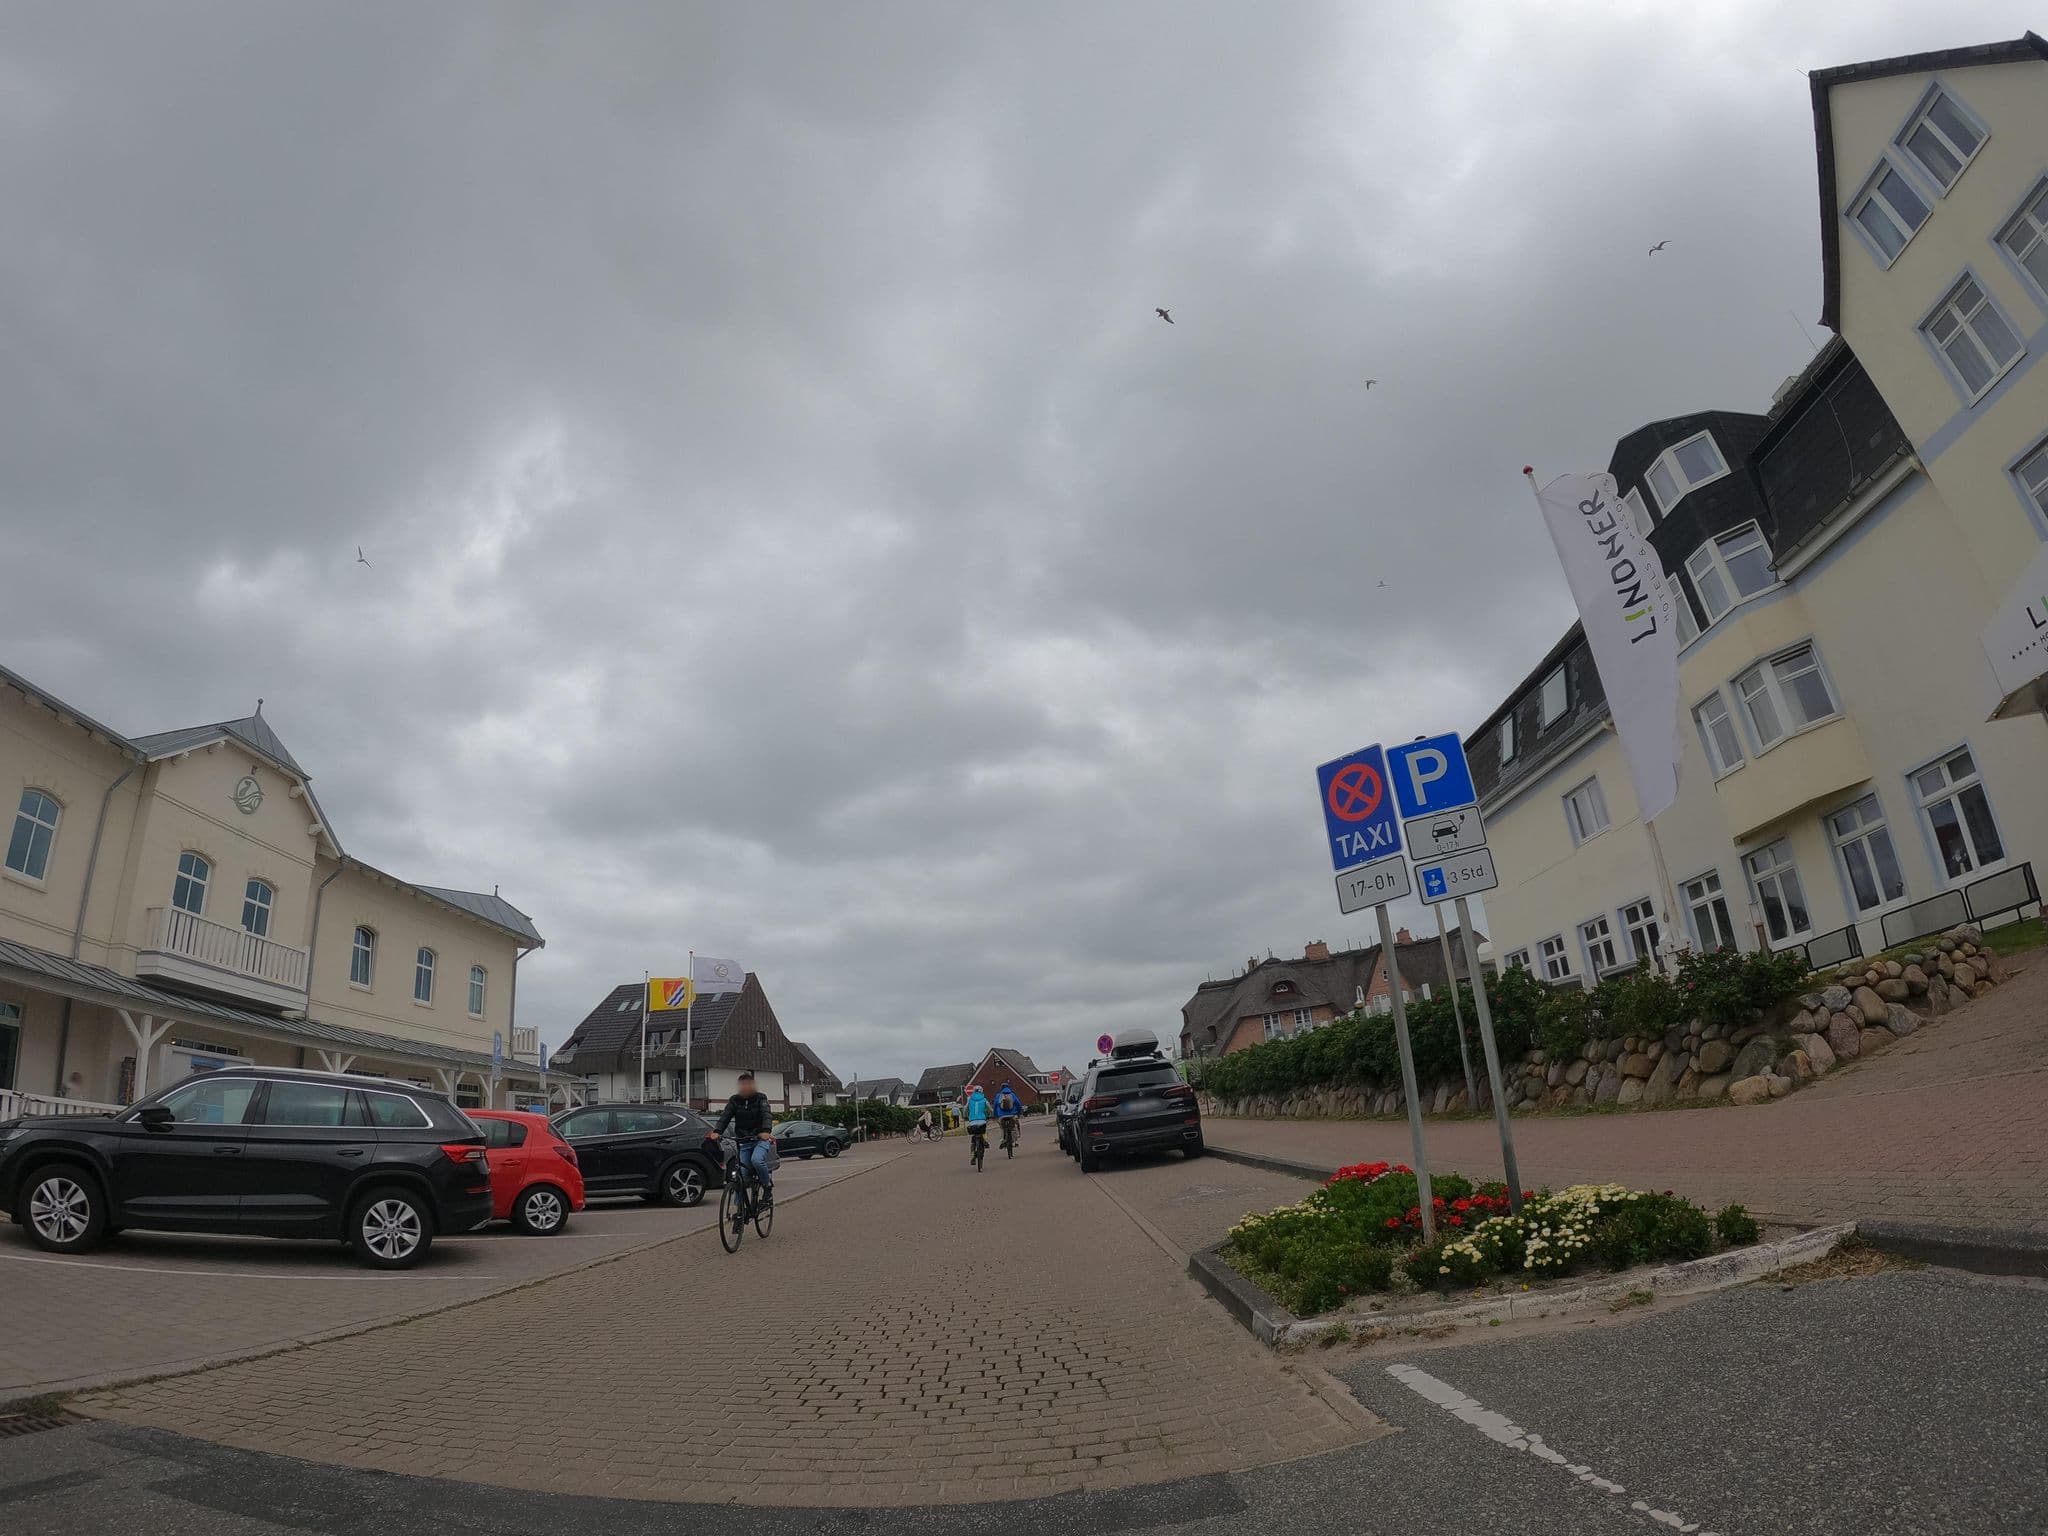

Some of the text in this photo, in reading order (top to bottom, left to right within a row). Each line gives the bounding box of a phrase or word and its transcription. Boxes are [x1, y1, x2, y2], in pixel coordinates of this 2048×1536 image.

[1405, 748, 1448, 806] P
[1335, 821, 1393, 858] TAXI
[1461, 865, 1488, 881] Std.
